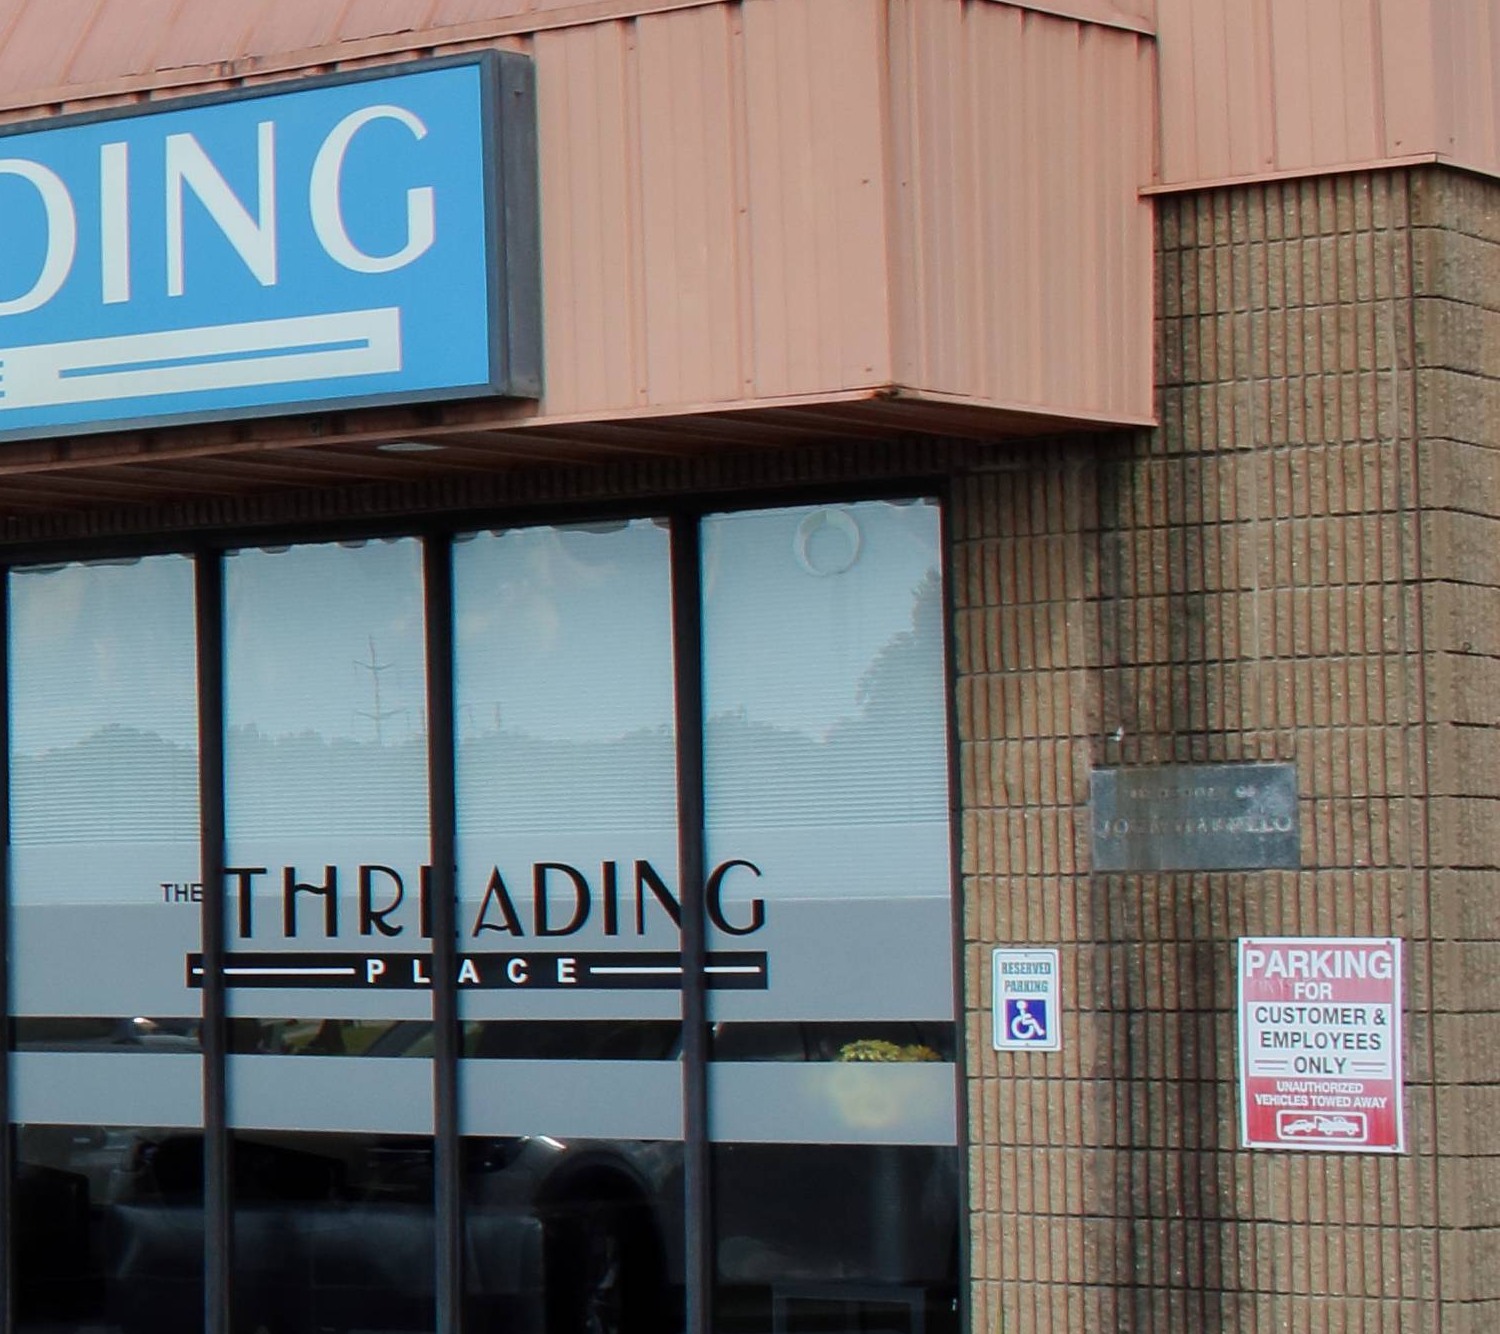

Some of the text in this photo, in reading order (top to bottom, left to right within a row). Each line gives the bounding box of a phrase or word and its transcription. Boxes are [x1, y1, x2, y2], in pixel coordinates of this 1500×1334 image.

[161, 883, 204, 903] THE
[366, 958, 577, 983] PLACE
[1001, 962, 1051, 974] RESERVED
[1245, 949, 1392, 979] PARKING
[1004, 980, 1048, 993] PARKING
[1294, 982, 1333, 1000] FOR
[1255, 1006, 1386, 1025] CUSTOMER &
[1260, 1031, 1381, 1050] EMPLOYEES
[1294, 1056, 1347, 1074] ONLY
[1276, 1081, 1363, 1094] UNAUTHORIZED
[1255, 1094, 1387, 1109] VEHICLES TOWED AWAY
